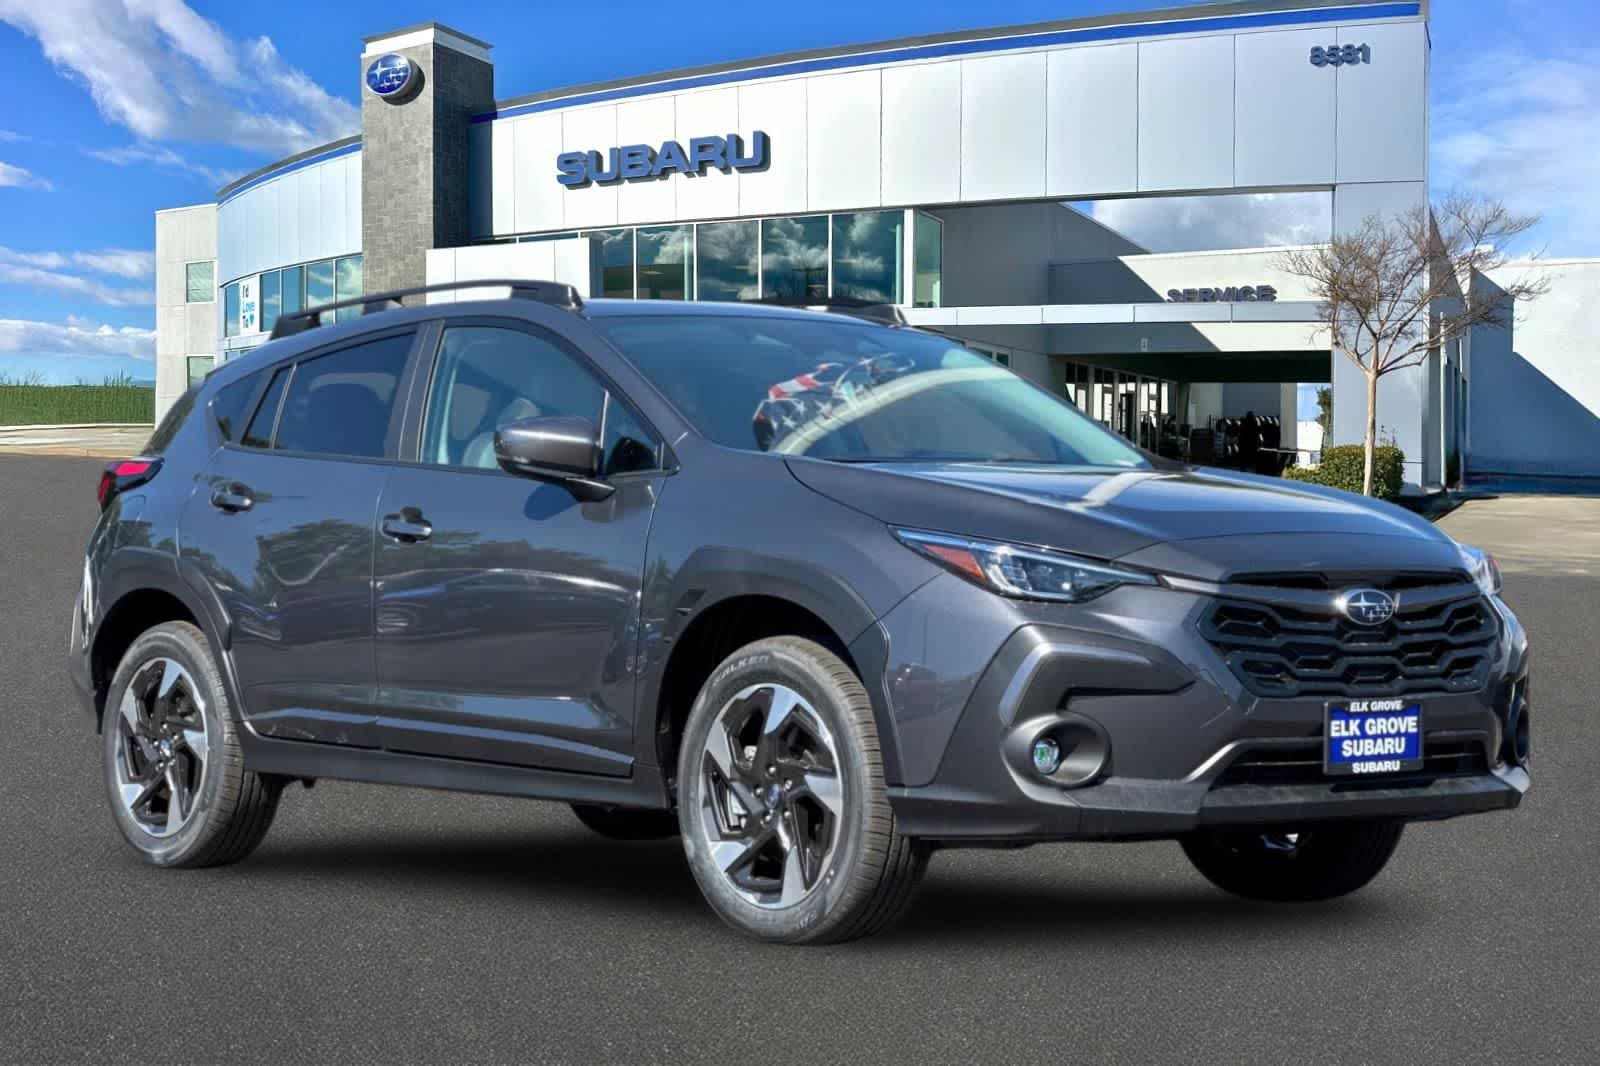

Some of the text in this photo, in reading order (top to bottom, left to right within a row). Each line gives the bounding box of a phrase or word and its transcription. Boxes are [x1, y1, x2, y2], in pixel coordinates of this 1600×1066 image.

[557, 130, 771, 190] SUBARU
[1167, 285, 1277, 302] SERVICE
[1350, 700, 1403, 712] ELK GROVE
[1331, 716, 1418, 736] ELK GROVE
[1342, 737, 1405, 757] SUBARU
[1352, 760, 1400, 773] SUBARU
